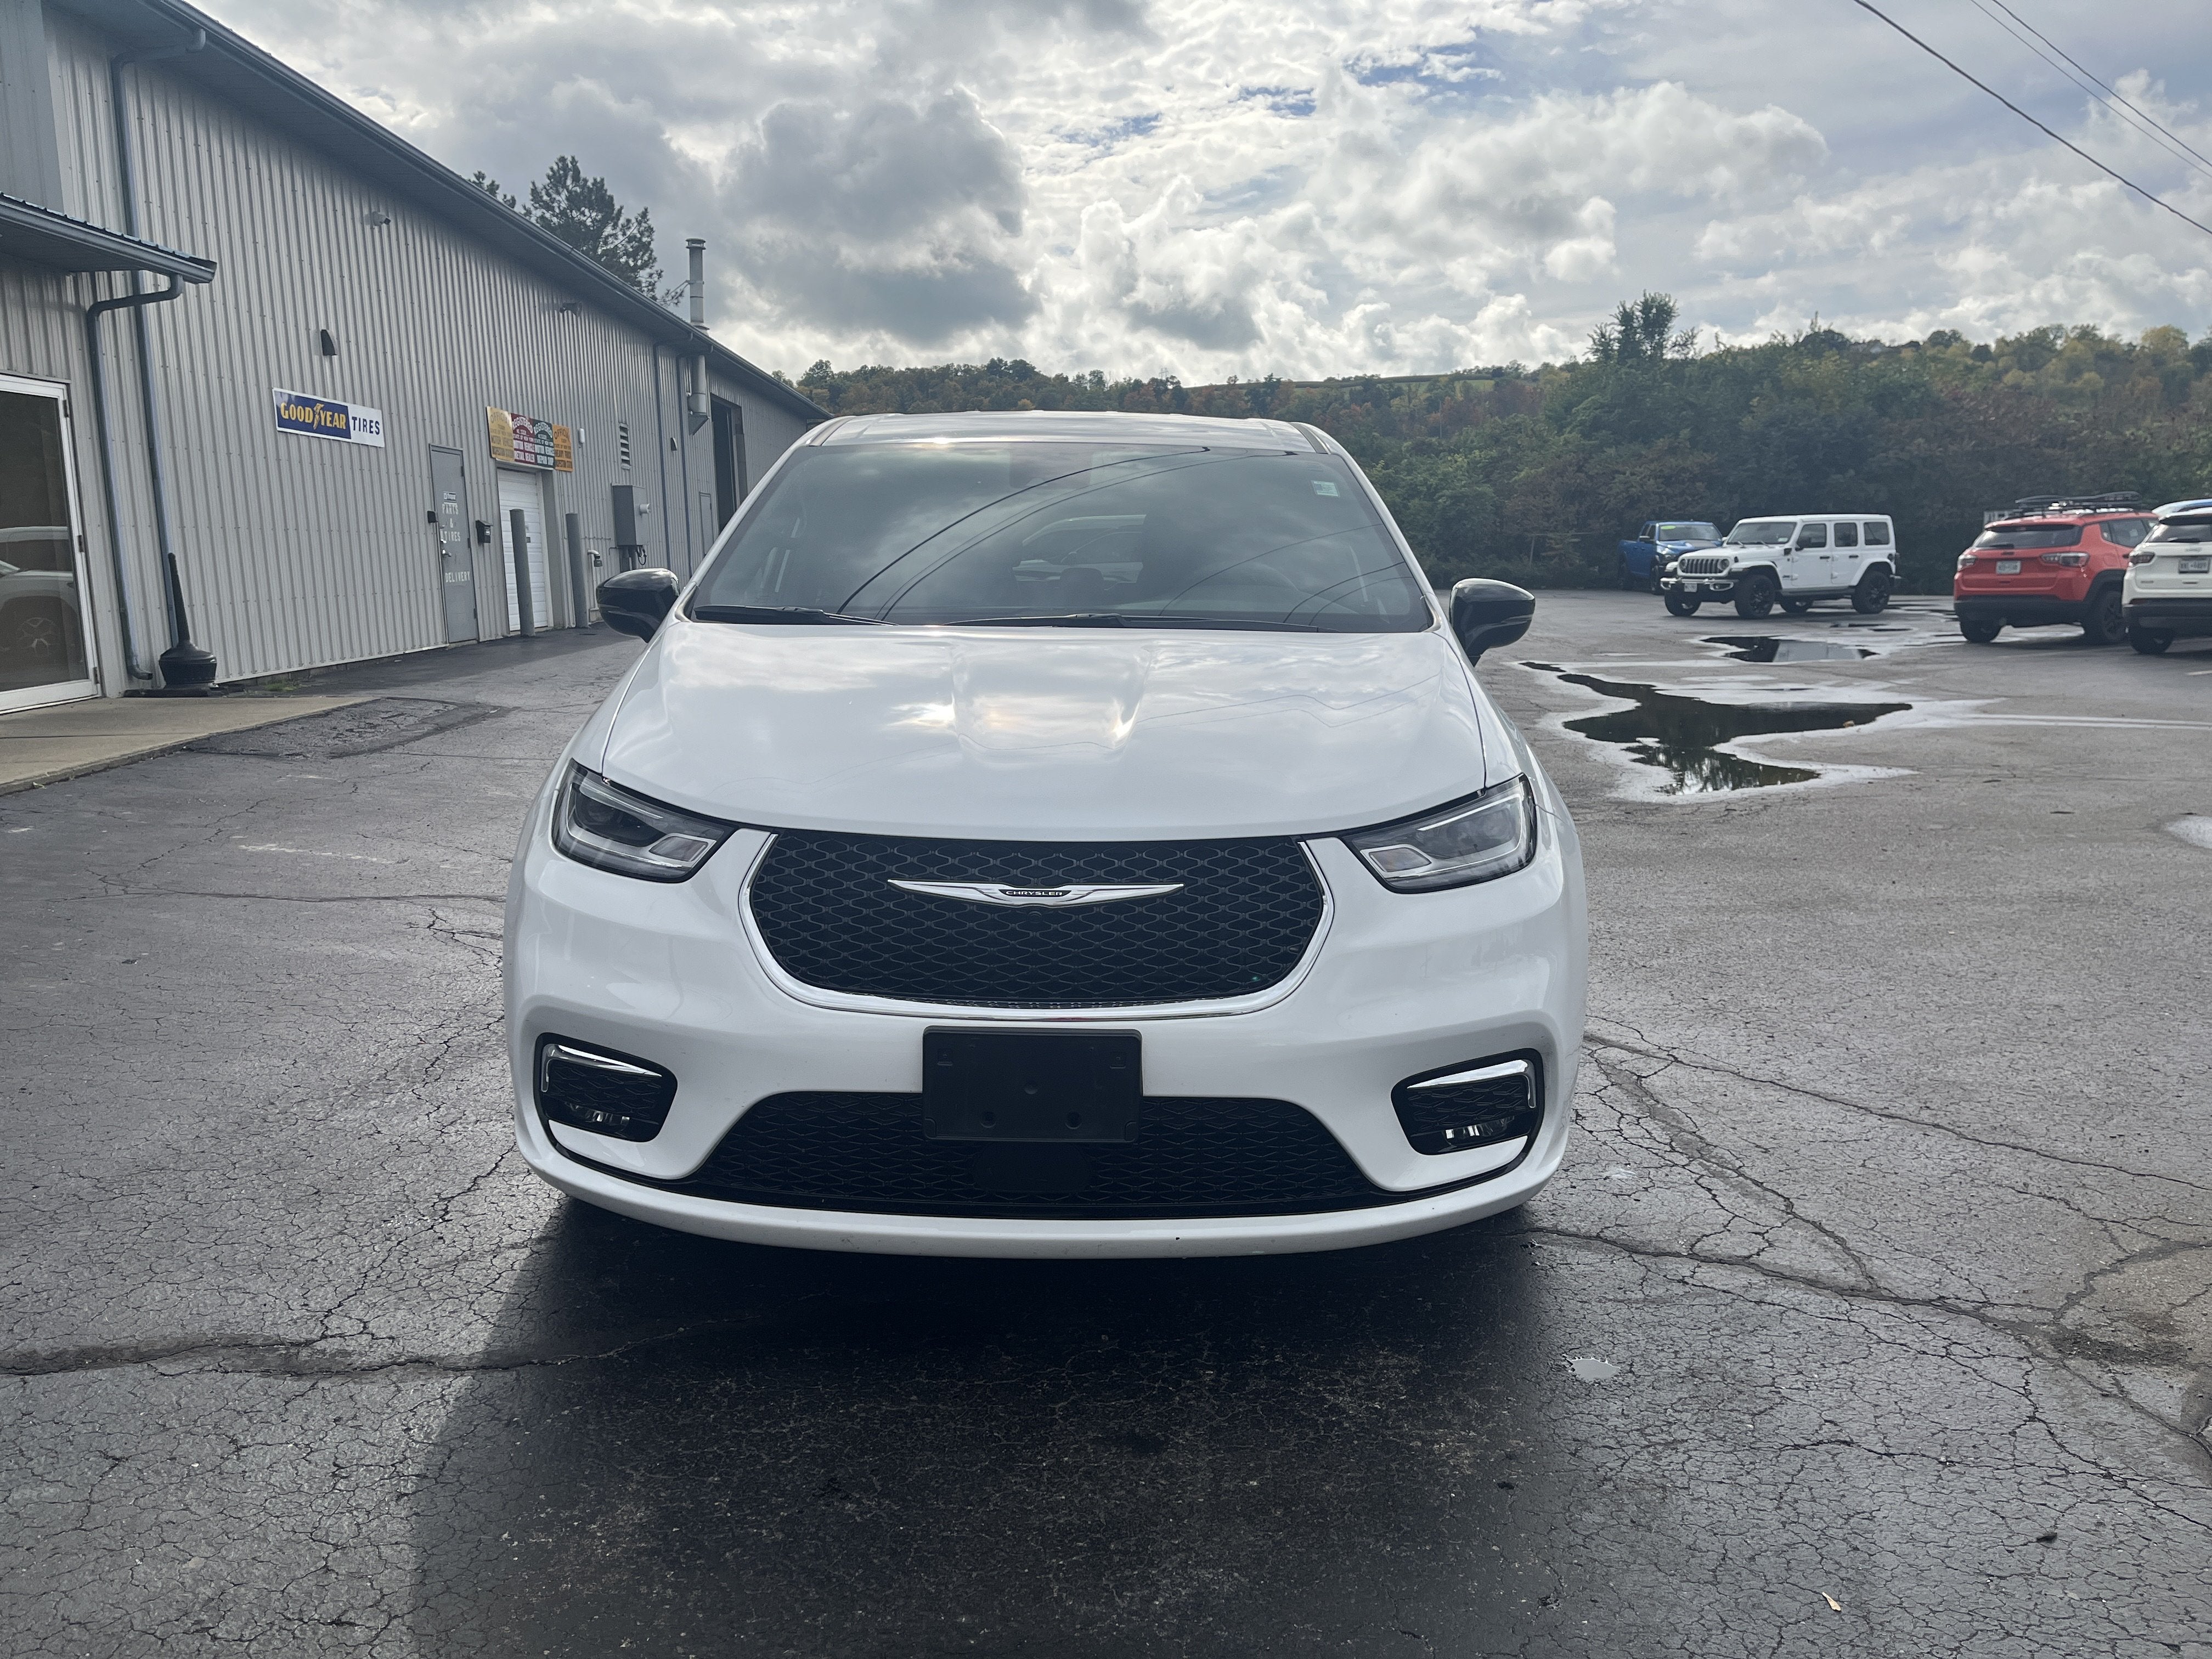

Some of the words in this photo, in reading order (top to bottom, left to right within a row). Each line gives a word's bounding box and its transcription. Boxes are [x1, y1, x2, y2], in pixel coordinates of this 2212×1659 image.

[280, 402, 346, 430] GOODYEAR
[352, 416, 380, 435] TIRES
[442, 504, 459, 515] PARTS
[444, 531, 461, 541] TIRES
[445, 571, 470, 583] DELIVERY
